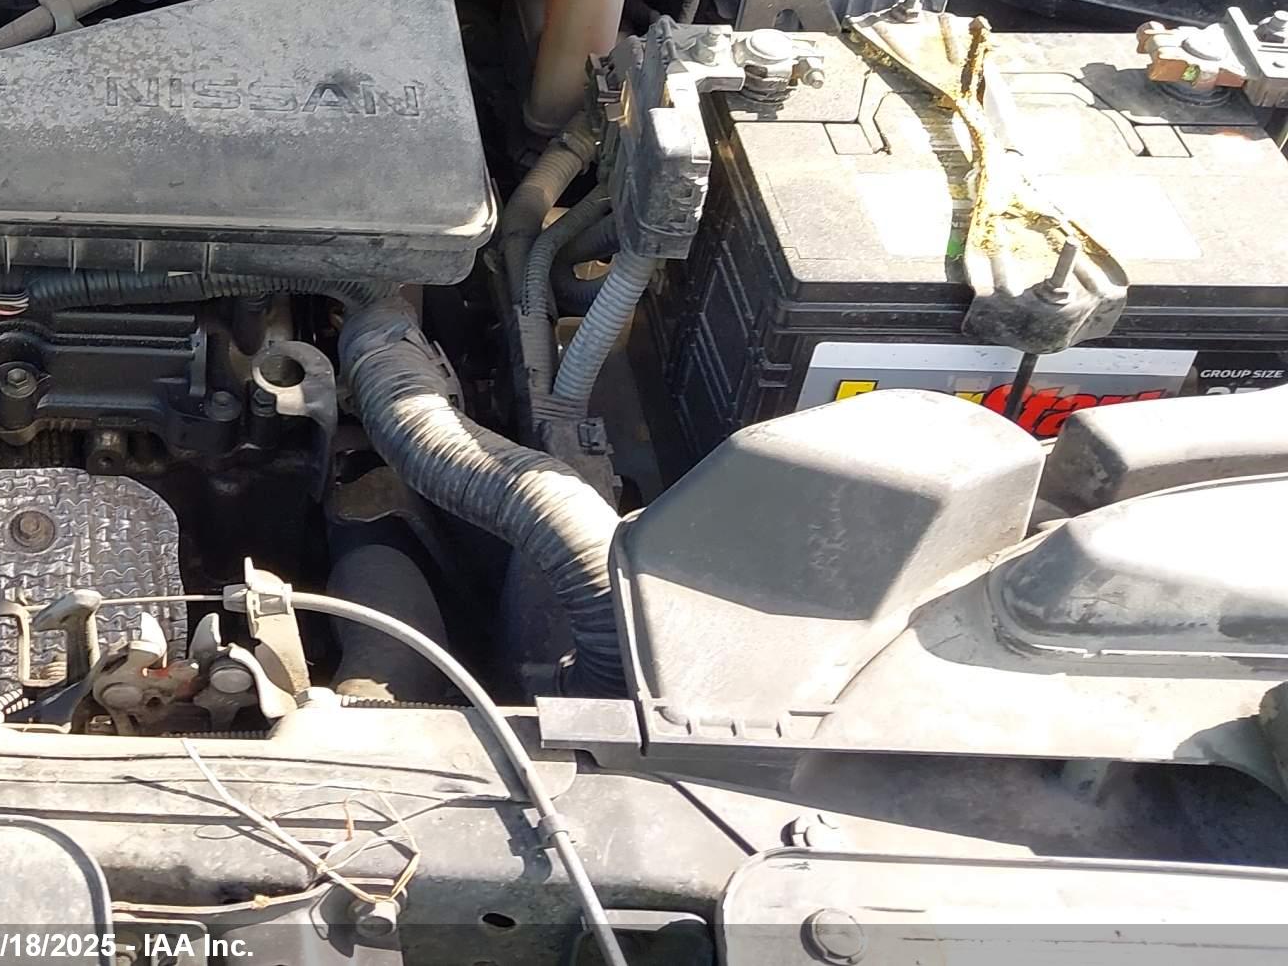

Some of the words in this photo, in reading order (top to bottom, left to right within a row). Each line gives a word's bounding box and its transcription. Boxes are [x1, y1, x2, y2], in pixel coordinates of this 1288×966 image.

[104, 74, 425, 118] NISSAN
[1199, 369, 1252, 379] GROUP
[1252, 369, 1286, 379] SIZE
